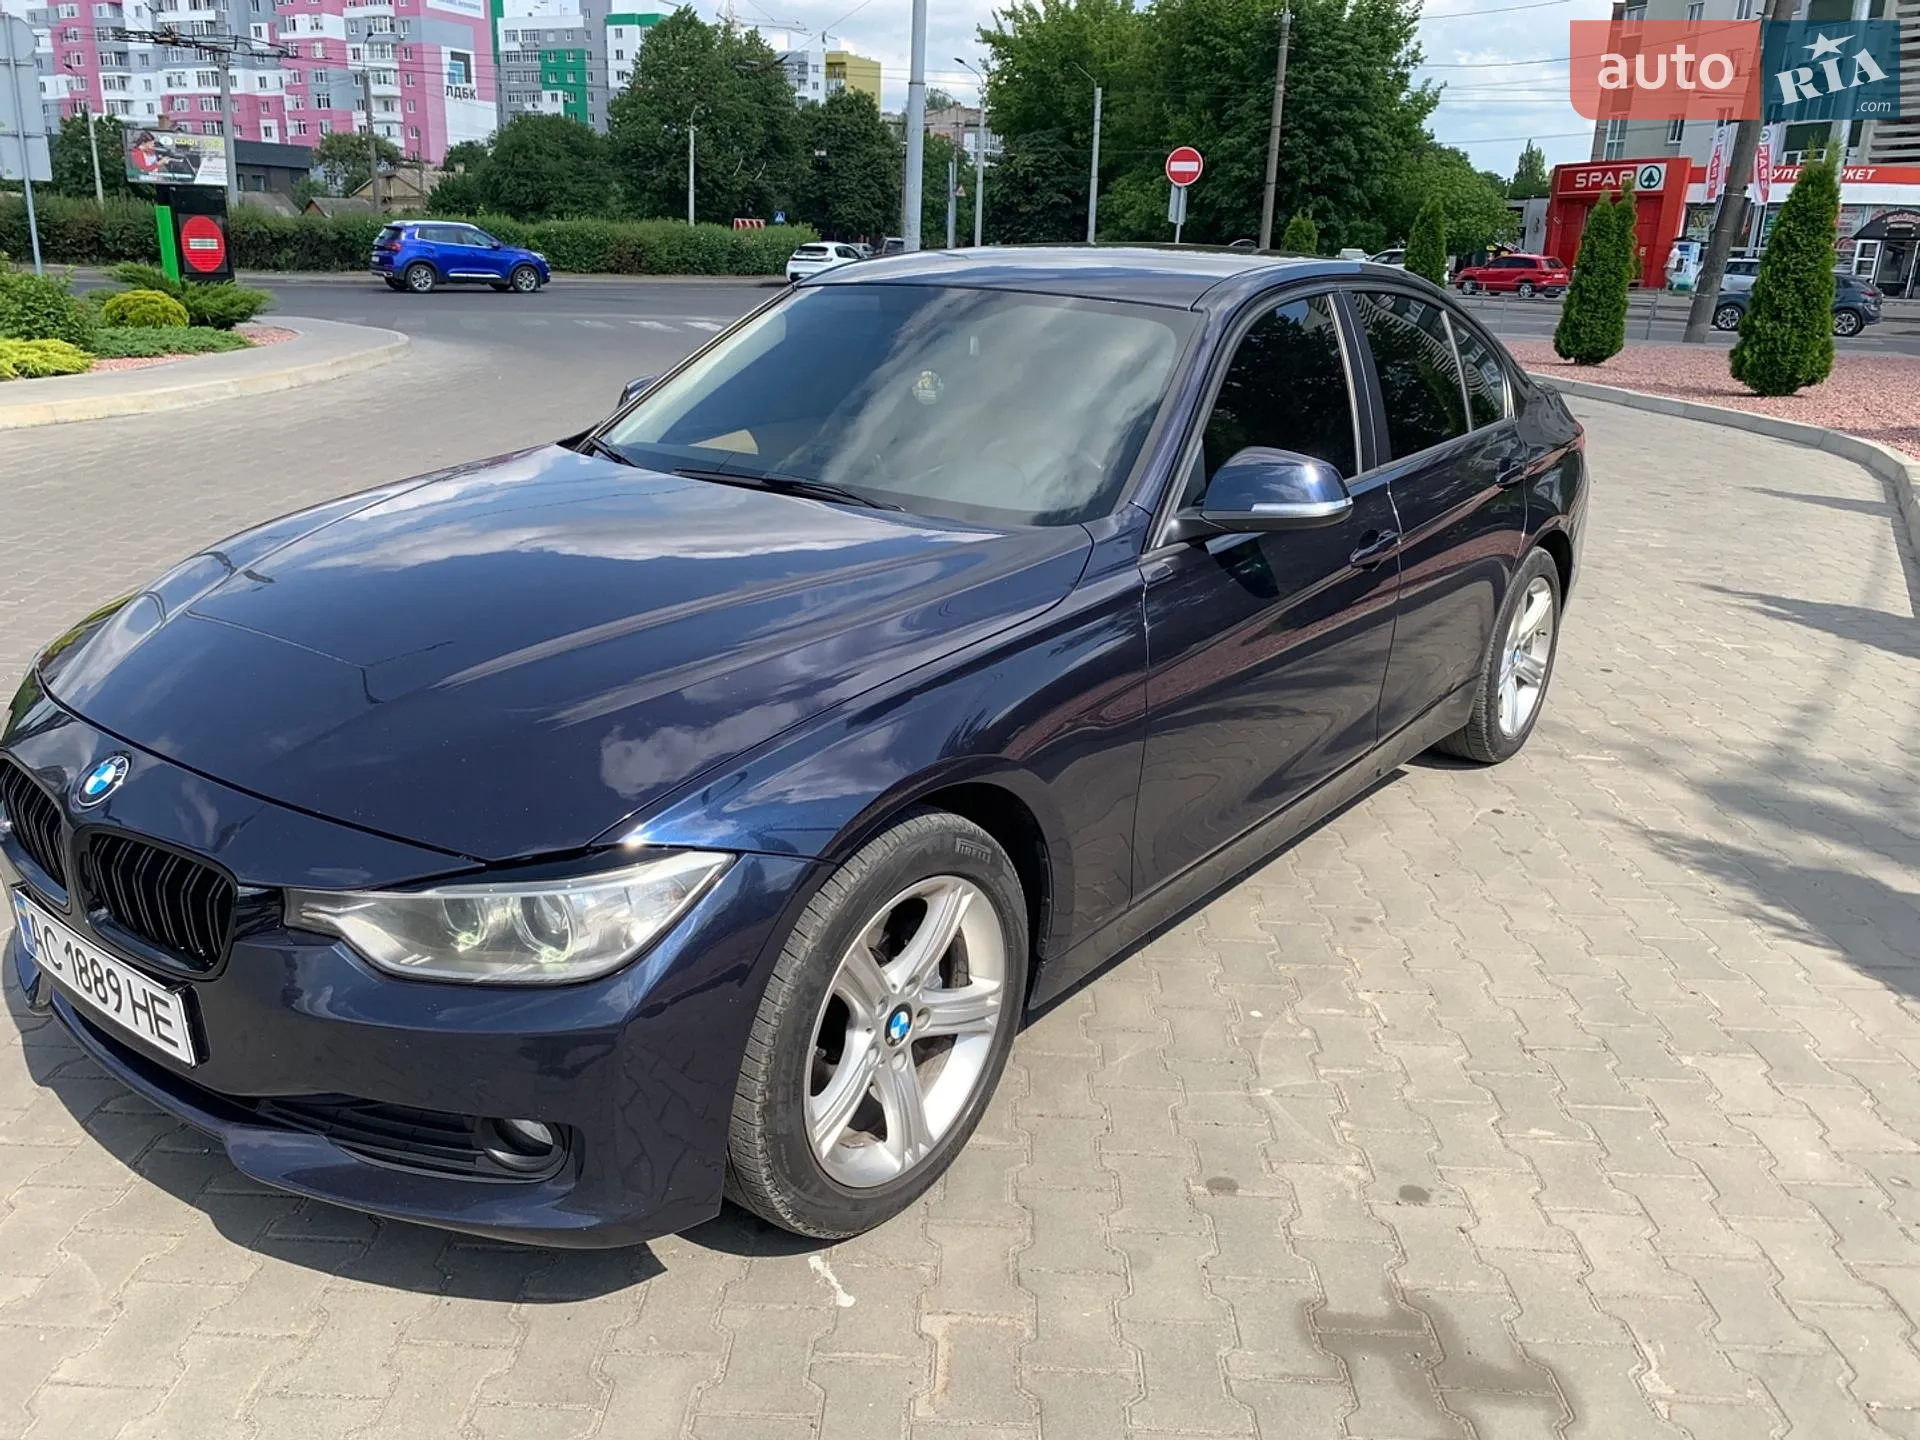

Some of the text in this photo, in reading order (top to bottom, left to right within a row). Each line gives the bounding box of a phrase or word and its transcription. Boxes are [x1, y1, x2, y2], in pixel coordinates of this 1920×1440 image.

[30, 912, 179, 1048] AC 1889 HE
